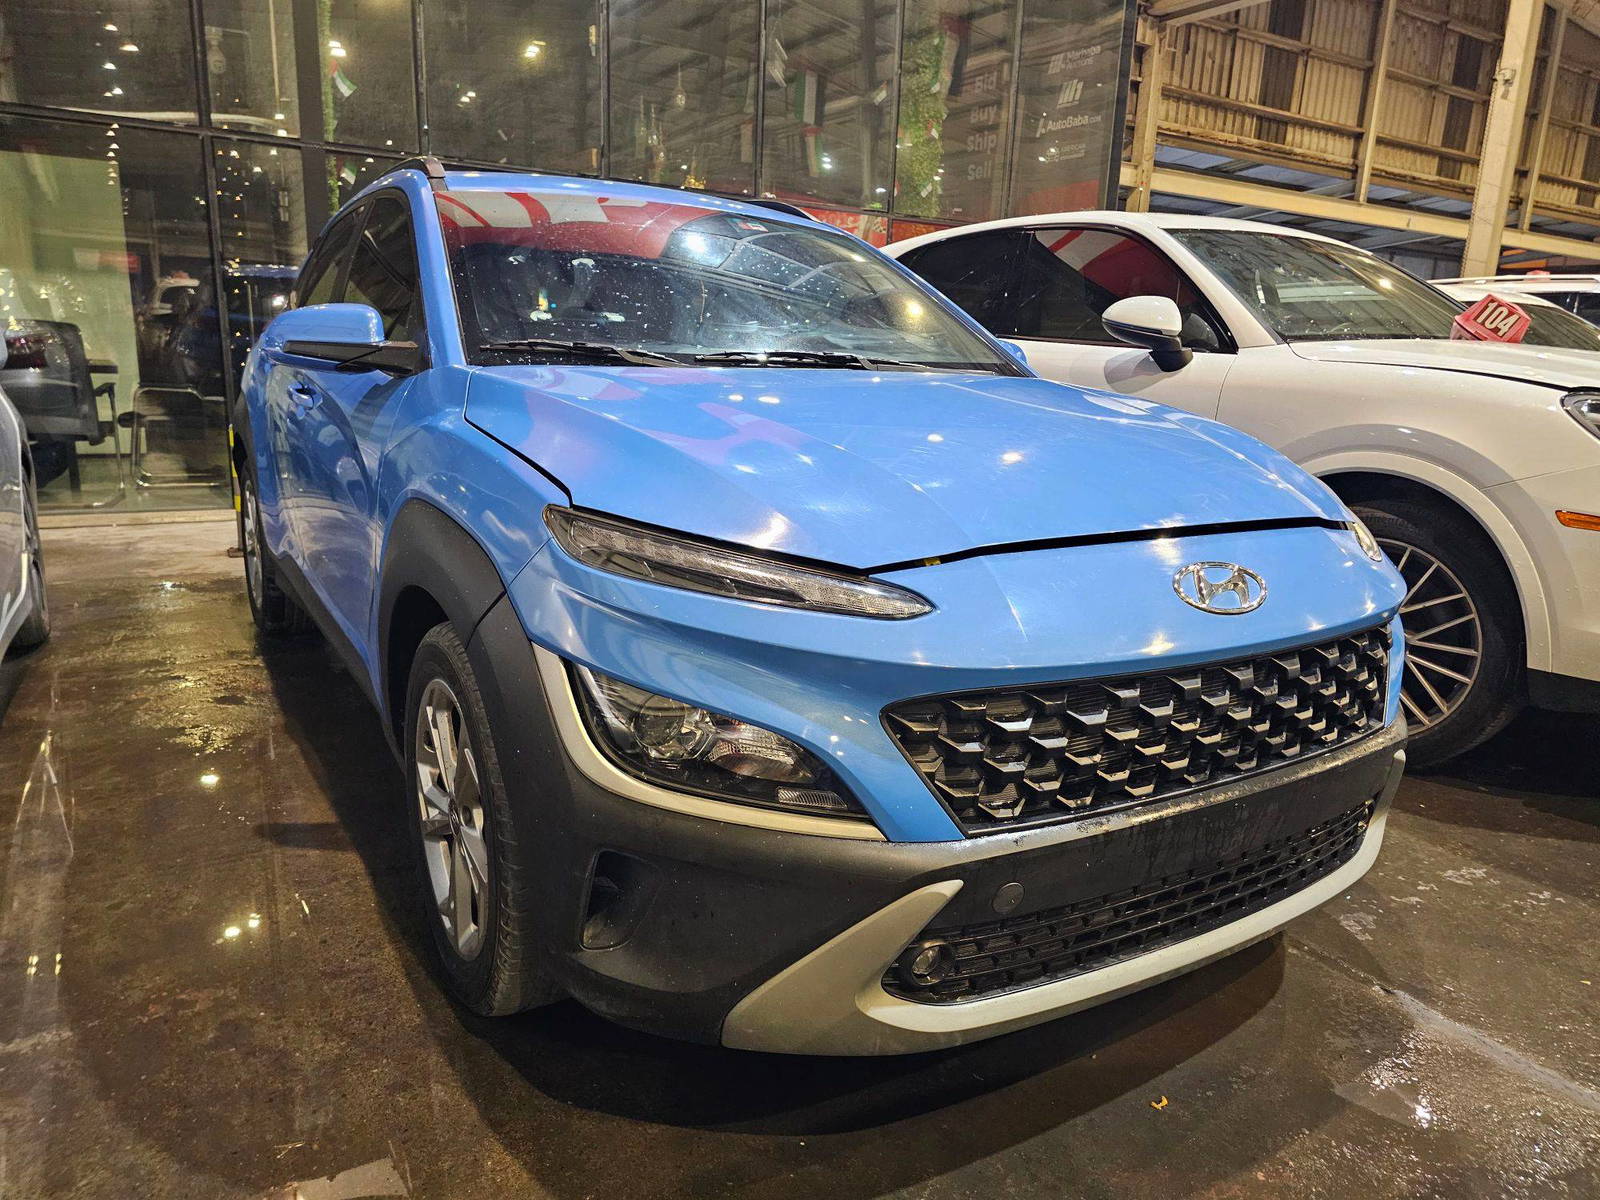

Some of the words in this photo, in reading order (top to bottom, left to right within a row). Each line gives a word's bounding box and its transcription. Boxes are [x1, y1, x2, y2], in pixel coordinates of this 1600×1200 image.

[974, 72, 997, 93] Bid
[970, 104, 997, 125] Buy
[967, 160, 992, 181] Sell
[1476, 302, 1520, 336] 104
